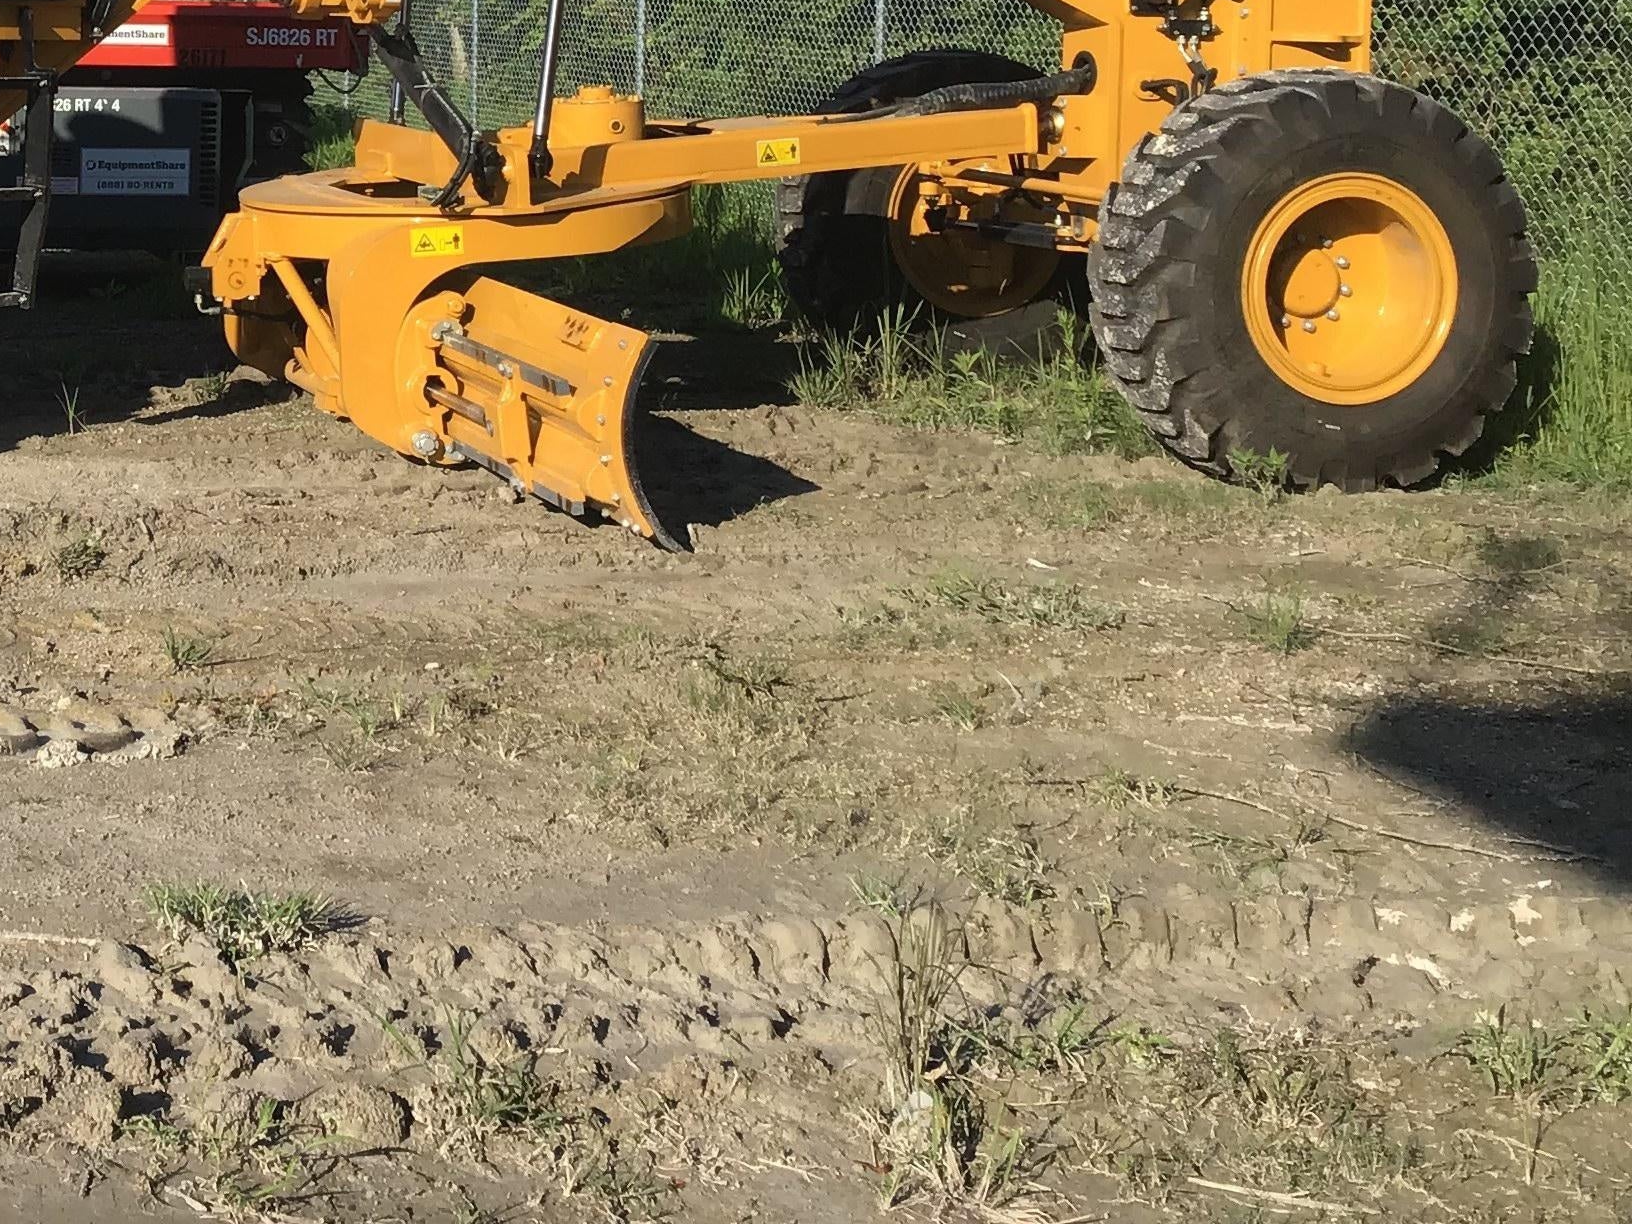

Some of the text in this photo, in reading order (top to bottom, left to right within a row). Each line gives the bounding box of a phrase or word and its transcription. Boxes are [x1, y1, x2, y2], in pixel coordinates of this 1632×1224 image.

[246, 27, 338, 46] SJ6826 RT
[74, 98, 92, 112] RT
[97, 160, 187, 171] EquipmentShare
